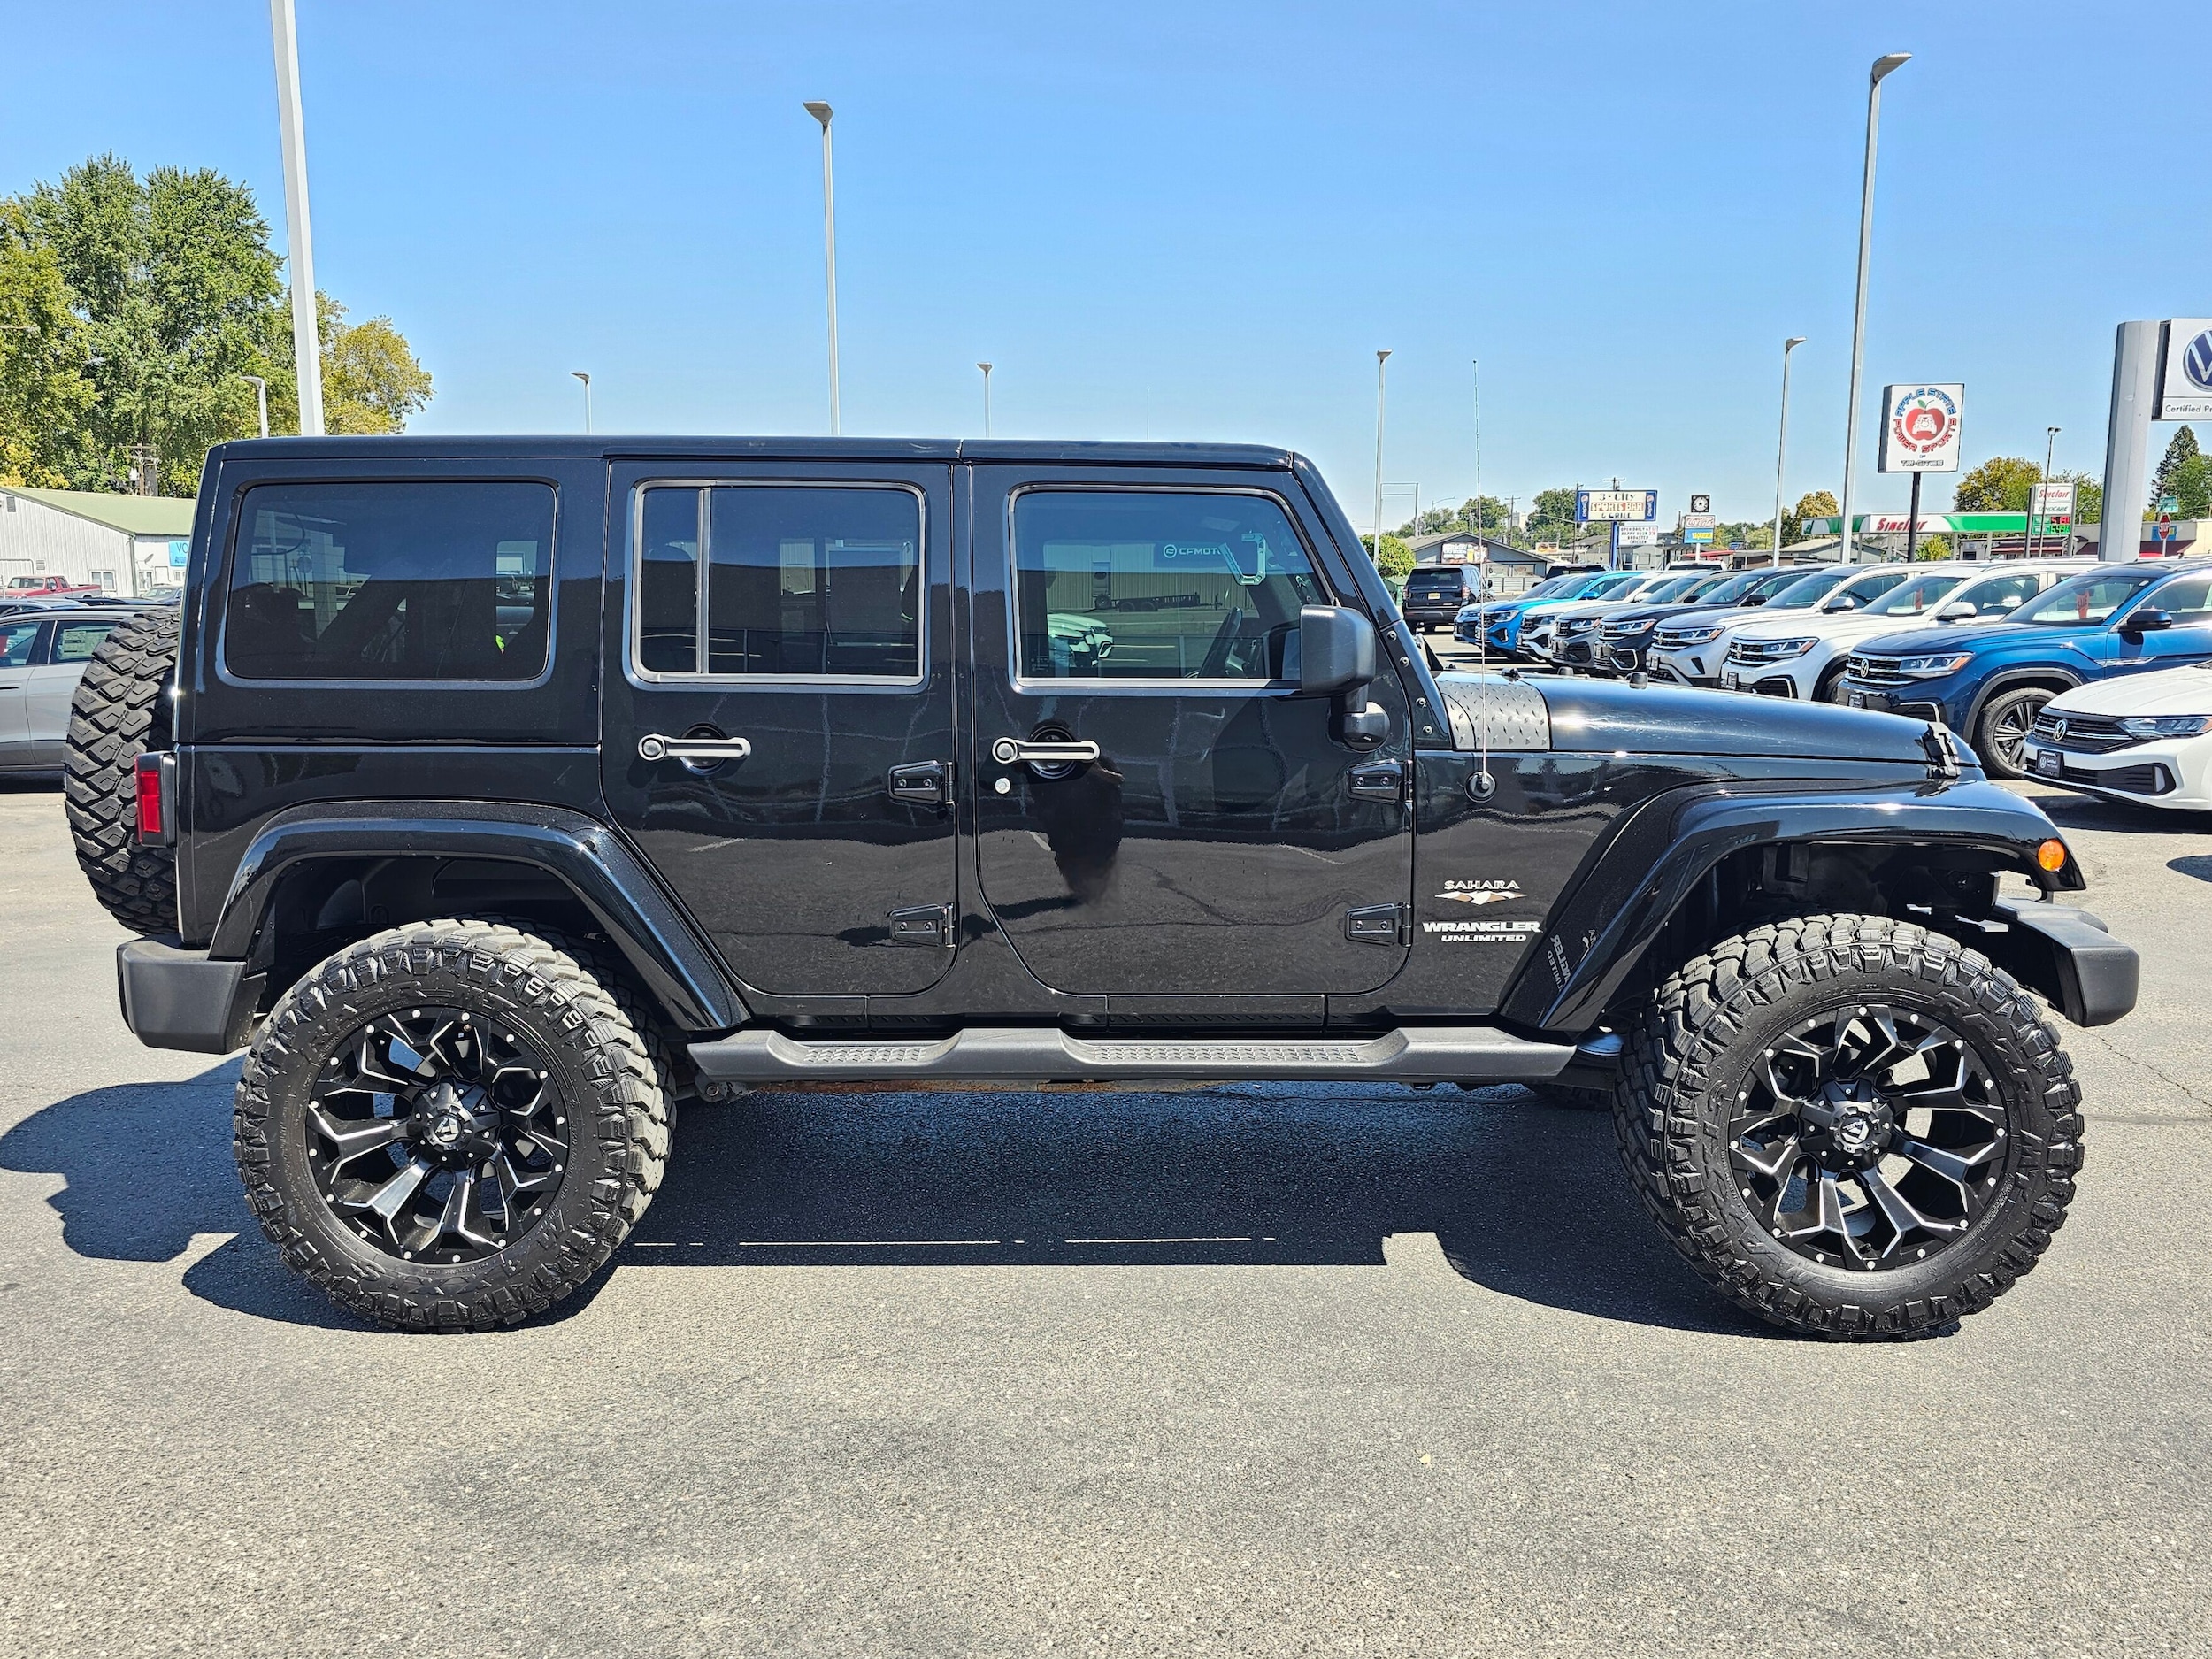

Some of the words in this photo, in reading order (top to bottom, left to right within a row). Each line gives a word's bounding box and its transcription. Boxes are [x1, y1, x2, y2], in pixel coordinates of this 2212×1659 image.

[1895, 388, 1925, 417] APPLE
[1927, 388, 1957, 415] STATE
[1893, 419, 1918, 452] POWER
[1921, 418, 1957, 453] SPORTS
[2038, 489, 2070, 498] Snclair
[1591, 503, 1624, 511] SPORTS
[1624, 503, 1643, 511] BAR
[1876, 518, 1928, 531] Sinclir
[2160, 522, 2170, 532] STOP
[1444, 880, 1521, 890] SAHARA
[1422, 921, 1543, 933] WRANGLER
